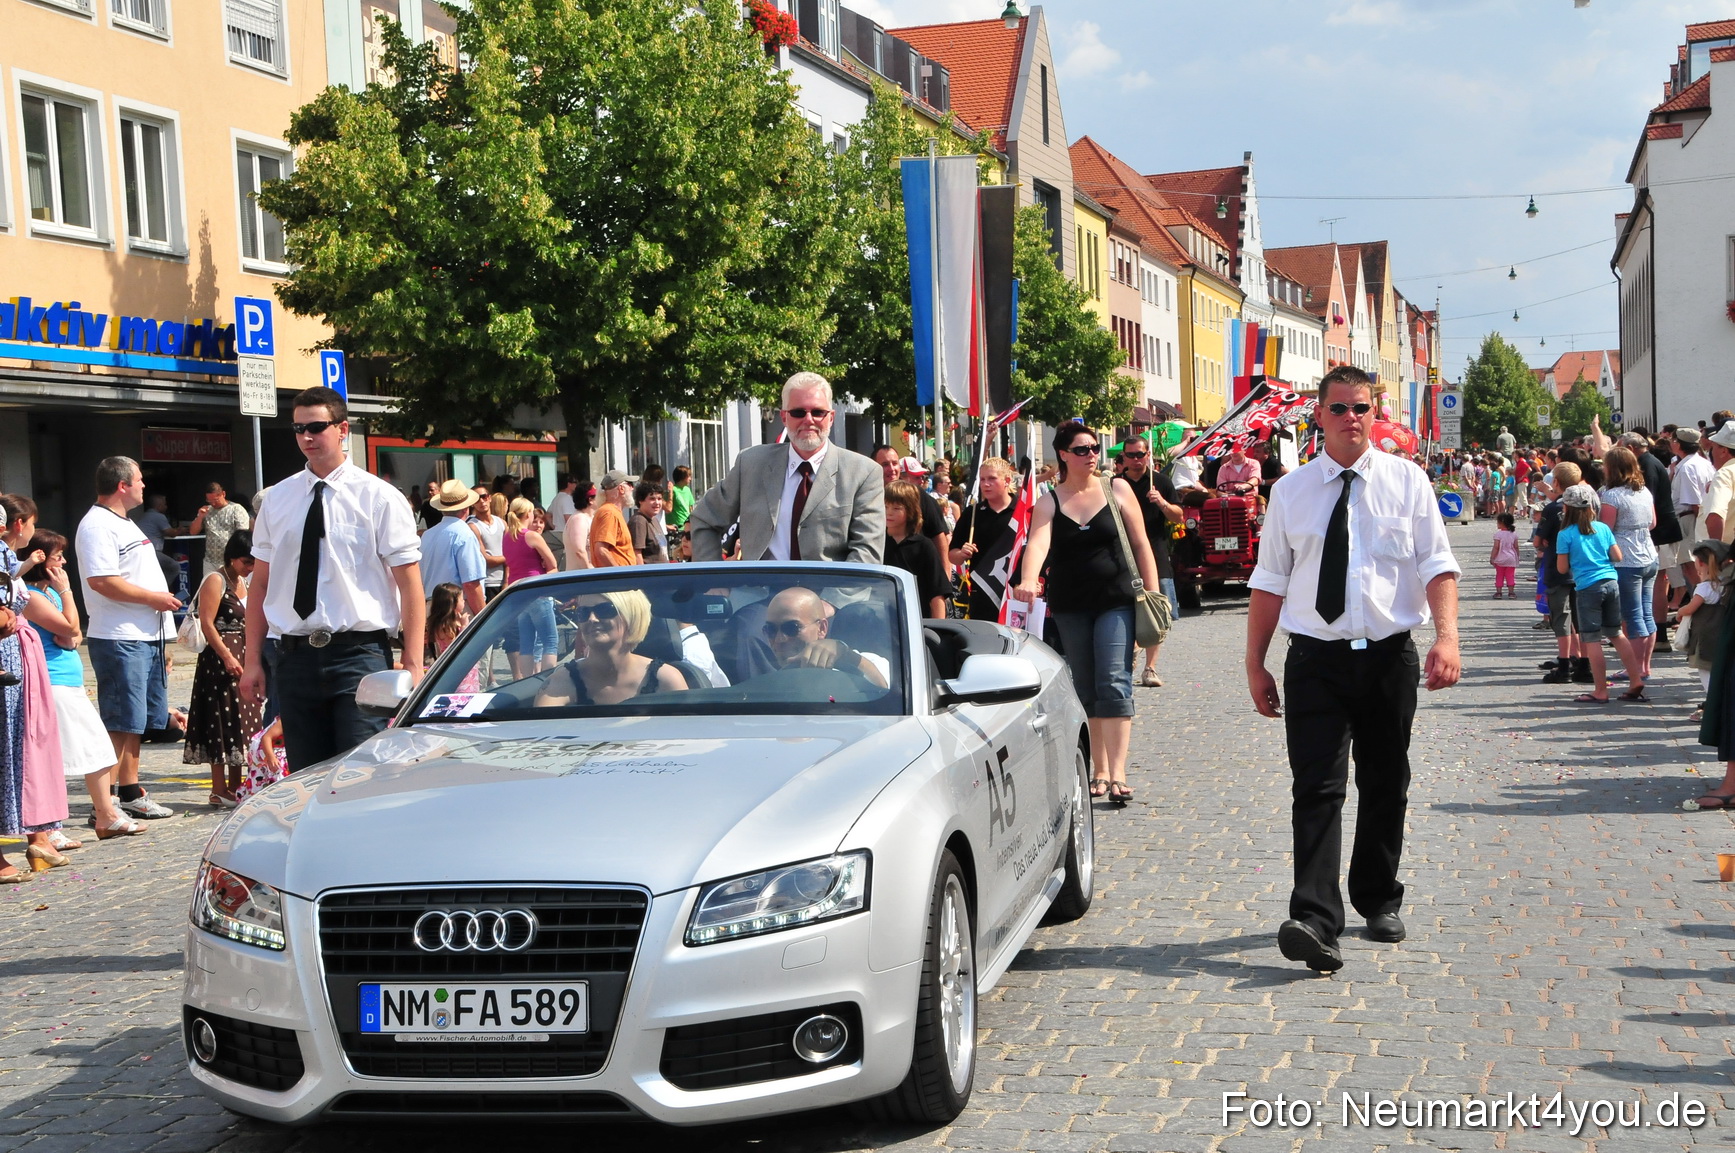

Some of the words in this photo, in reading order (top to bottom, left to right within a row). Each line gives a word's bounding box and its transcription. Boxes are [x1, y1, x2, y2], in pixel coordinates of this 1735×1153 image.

[243, 304, 265, 348] P
[111, 316, 236, 361] markt
[258, 362, 268, 370] mit
[242, 369, 273, 380] Parkschein
[245, 380, 271, 391] werktags
[242, 391, 259, 399] Mo-Fr
[243, 401, 250, 409] Sa
[155, 434, 189, 459] Super
[192, 436, 228, 460] Kebap
[985, 745, 1017, 849] A5
[1012, 859, 1026, 882] Das
[1024, 843, 1038, 867] neue
[1036, 826, 1048, 854] Audi
[383, 989, 430, 1027] NM
[454, 989, 502, 1027] FA
[510, 988, 581, 1027] 589
[366, 1013, 374, 1024] D
[416, 1034, 528, 1042] www.Fischer-Automobile.de
